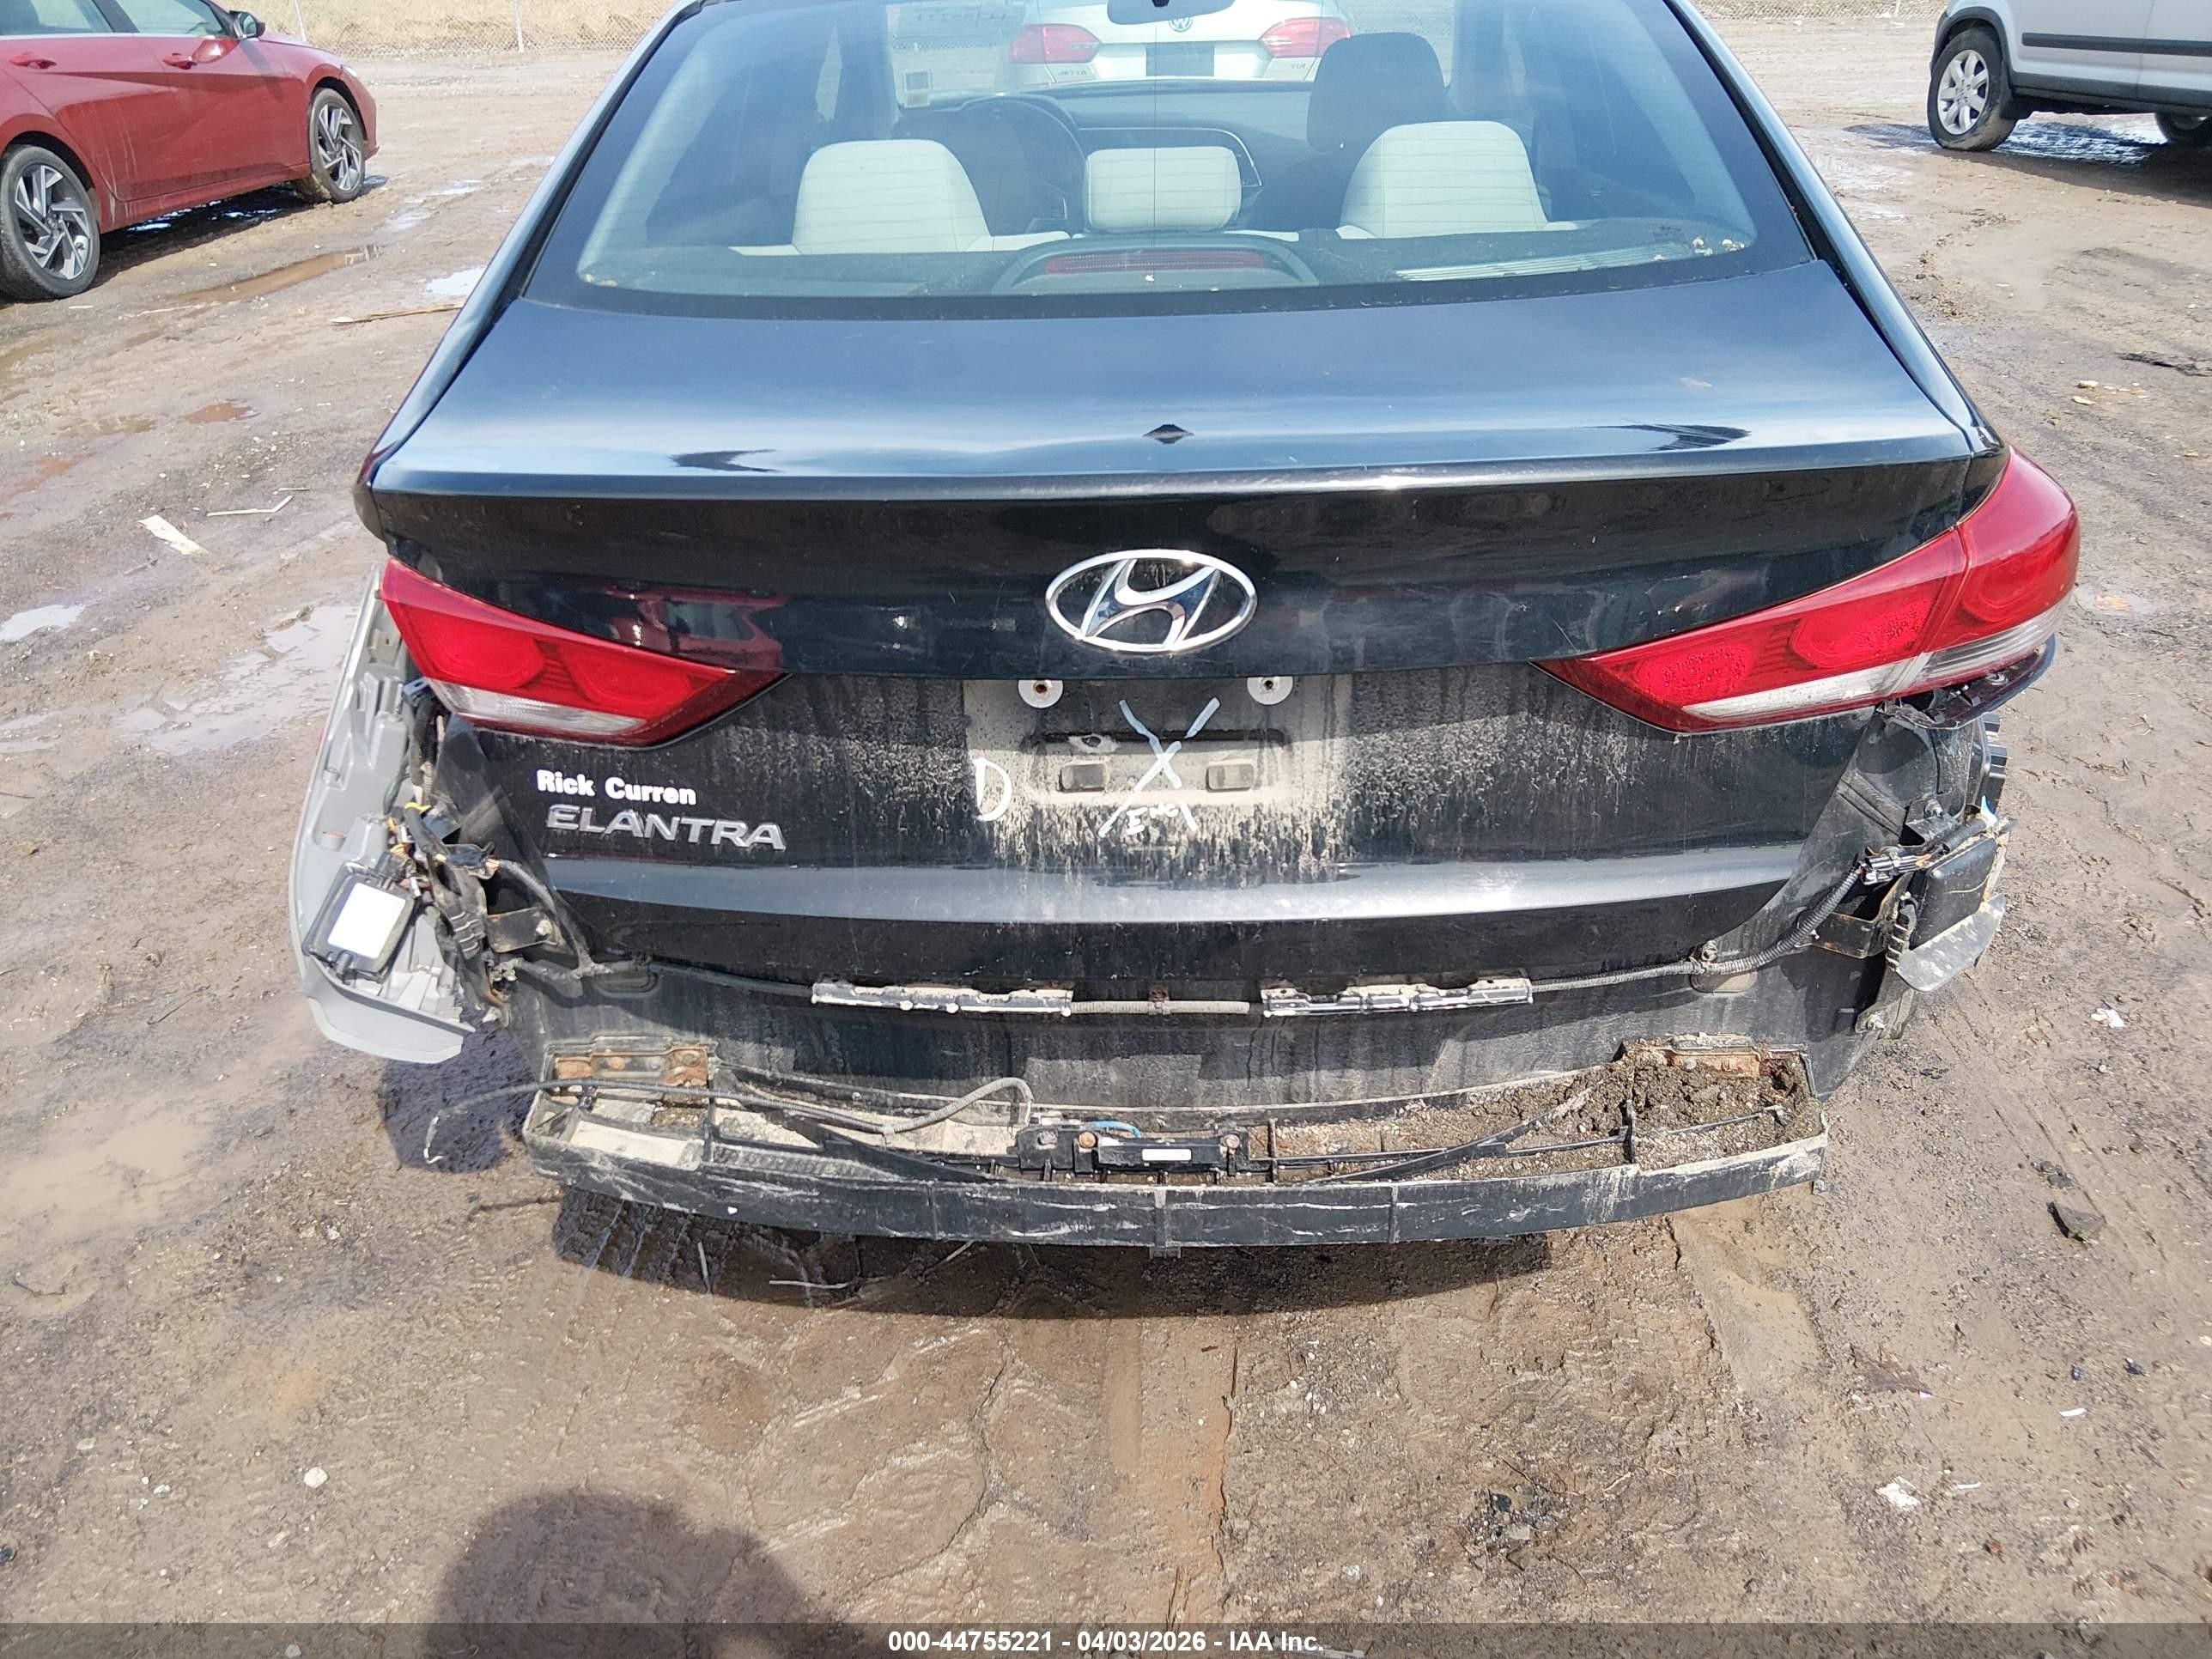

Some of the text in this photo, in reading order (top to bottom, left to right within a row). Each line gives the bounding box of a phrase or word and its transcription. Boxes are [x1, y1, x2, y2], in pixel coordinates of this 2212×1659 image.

[537, 769, 595, 797] Rick
[972, 757, 1013, 822] D
[545, 803, 787, 852] ELANTRA
